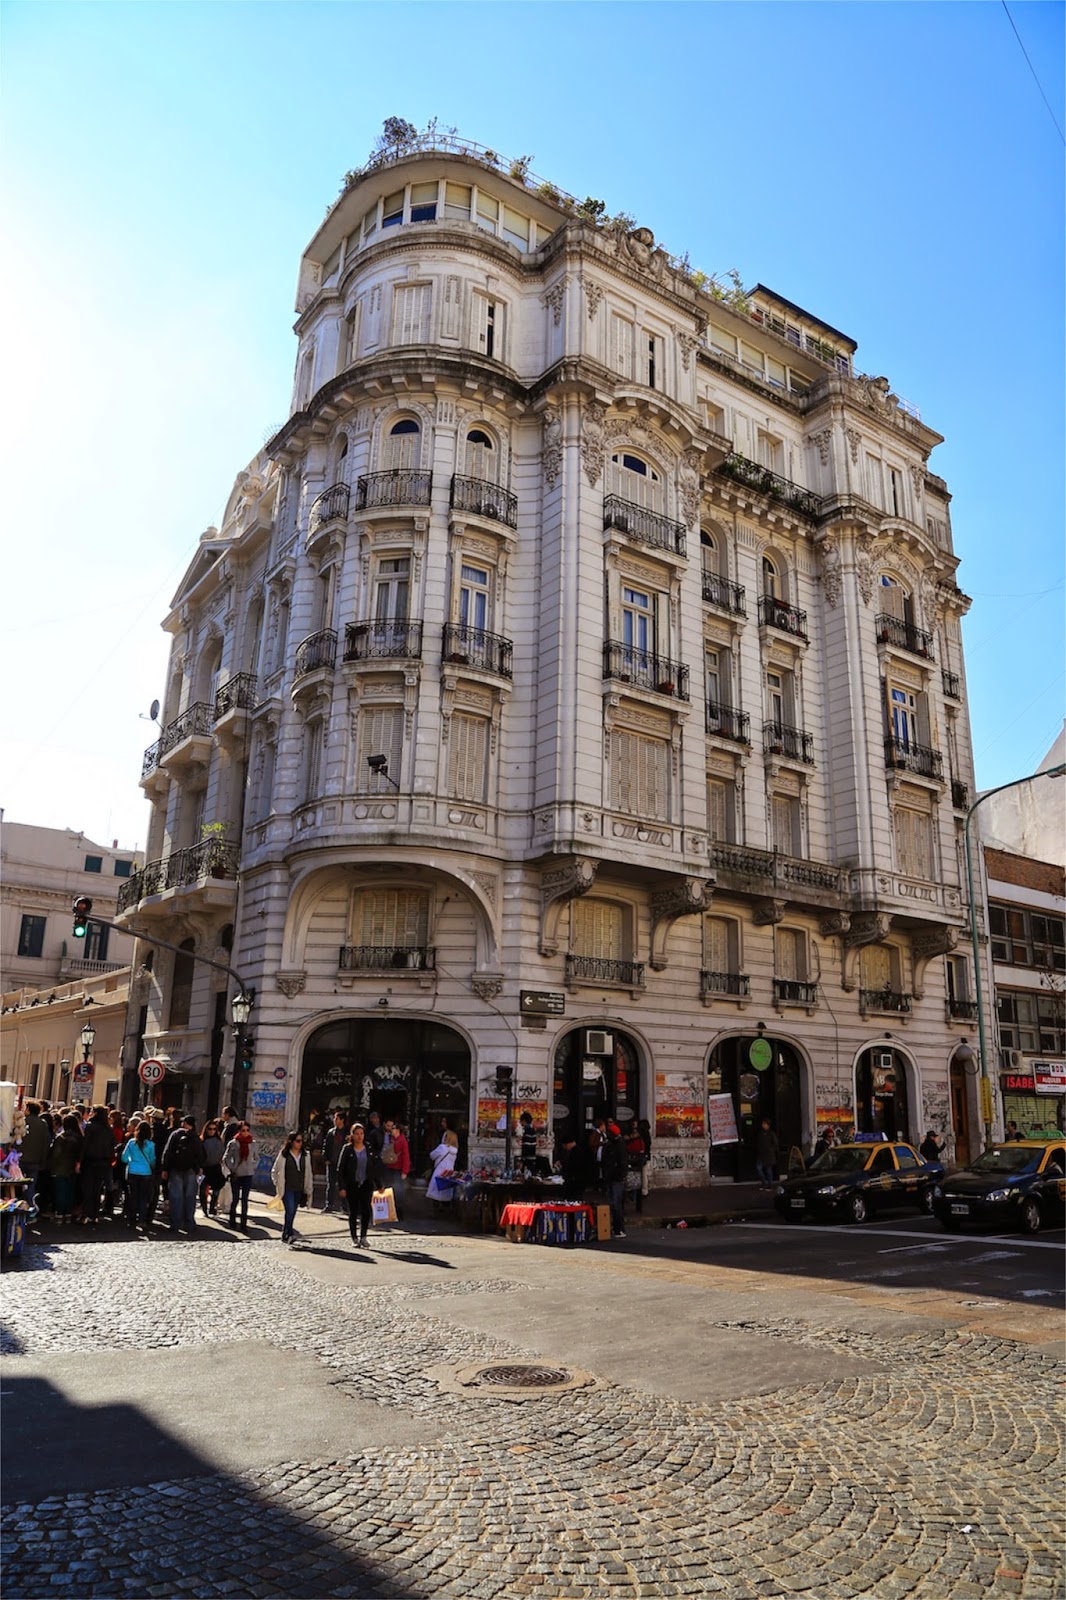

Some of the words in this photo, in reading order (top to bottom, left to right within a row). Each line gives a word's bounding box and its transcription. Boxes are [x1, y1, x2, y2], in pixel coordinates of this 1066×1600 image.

[80, 1064, 88, 1075] E
[144, 1066, 161, 1078] 30
[1007, 1076, 1035, 1089] ISABE
